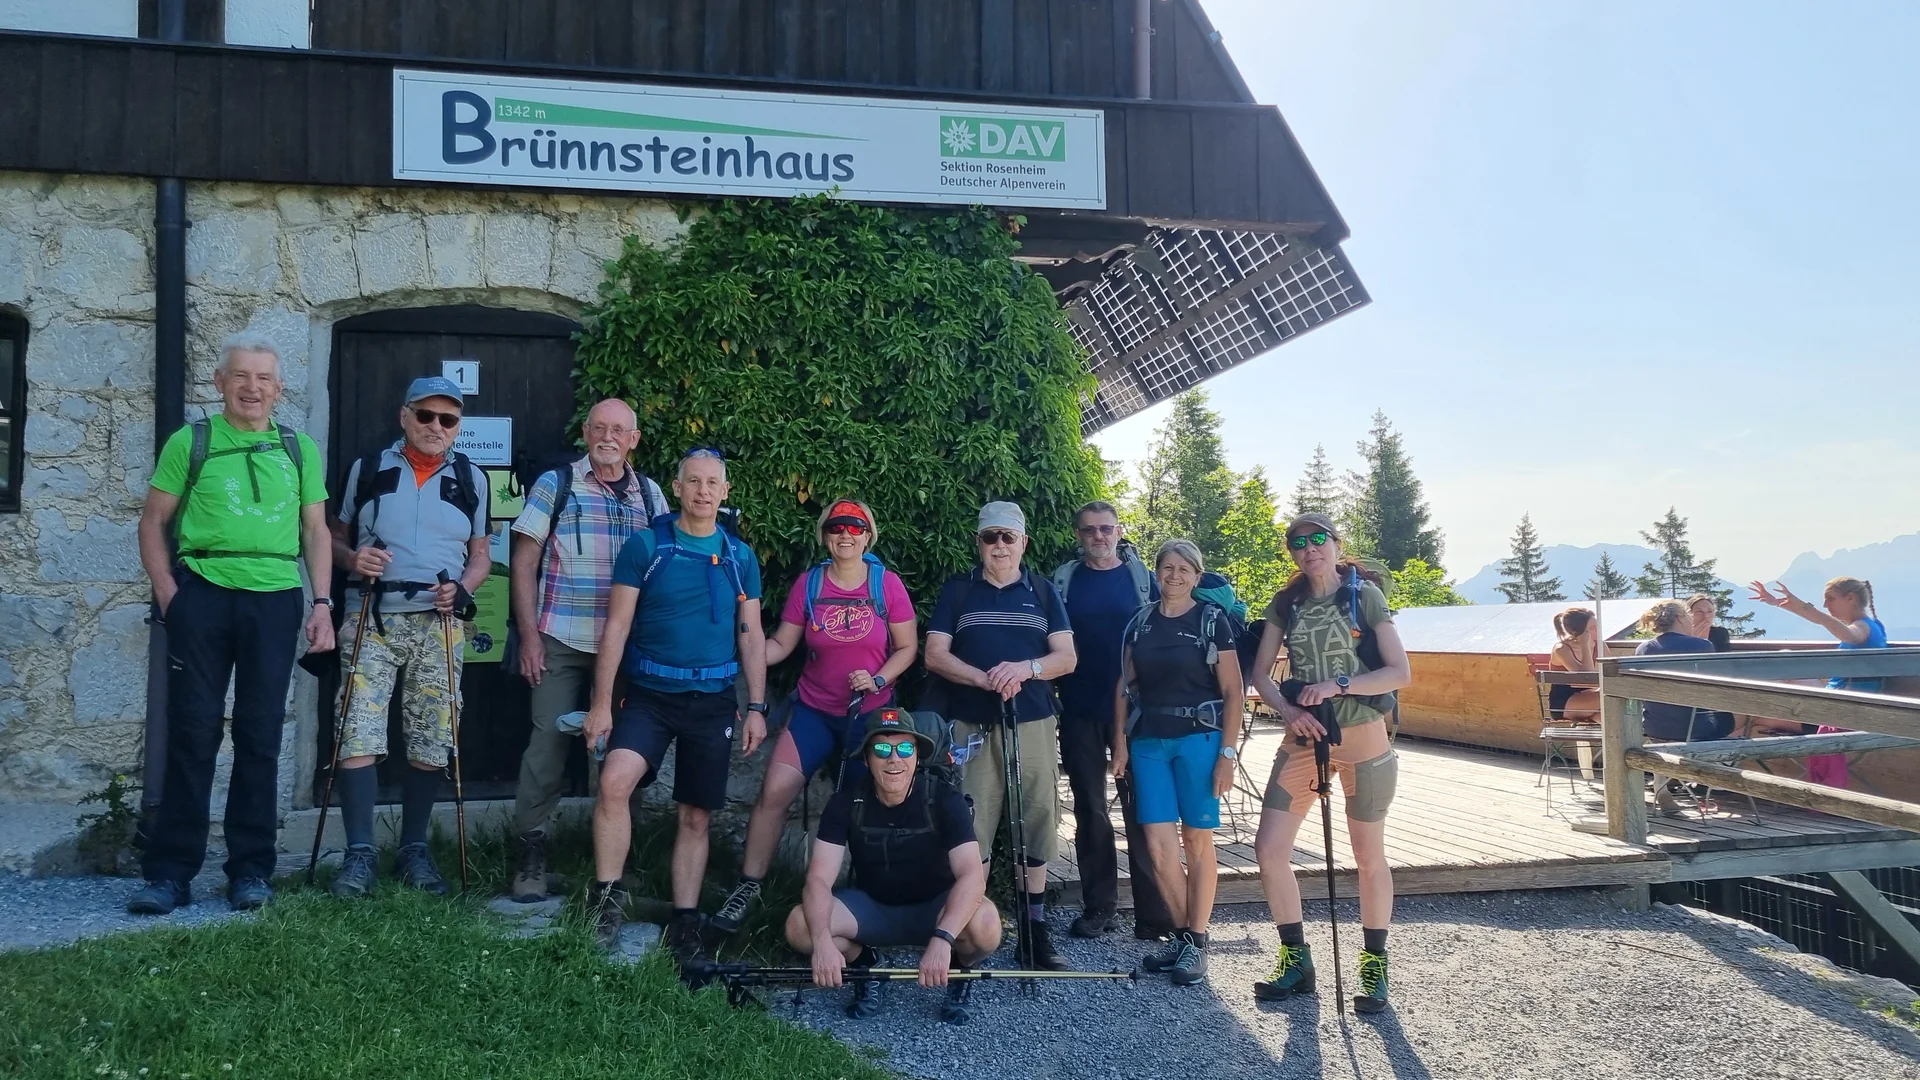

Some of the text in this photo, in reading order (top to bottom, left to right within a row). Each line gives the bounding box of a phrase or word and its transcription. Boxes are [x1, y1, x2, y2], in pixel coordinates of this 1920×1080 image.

[497, 104, 546, 120] 1342 m
[442, 90, 855, 183] Brünnsteinhaus
[979, 123, 1062, 157] DAV
[940, 161, 1046, 175] Sektion Rosenheim
[940, 175, 1066, 191] Deutscher Alpenverein
[455, 366, 465, 384] 1
[458, 428, 475, 437] ine
[643, 555, 663, 582] ORTOVOX
